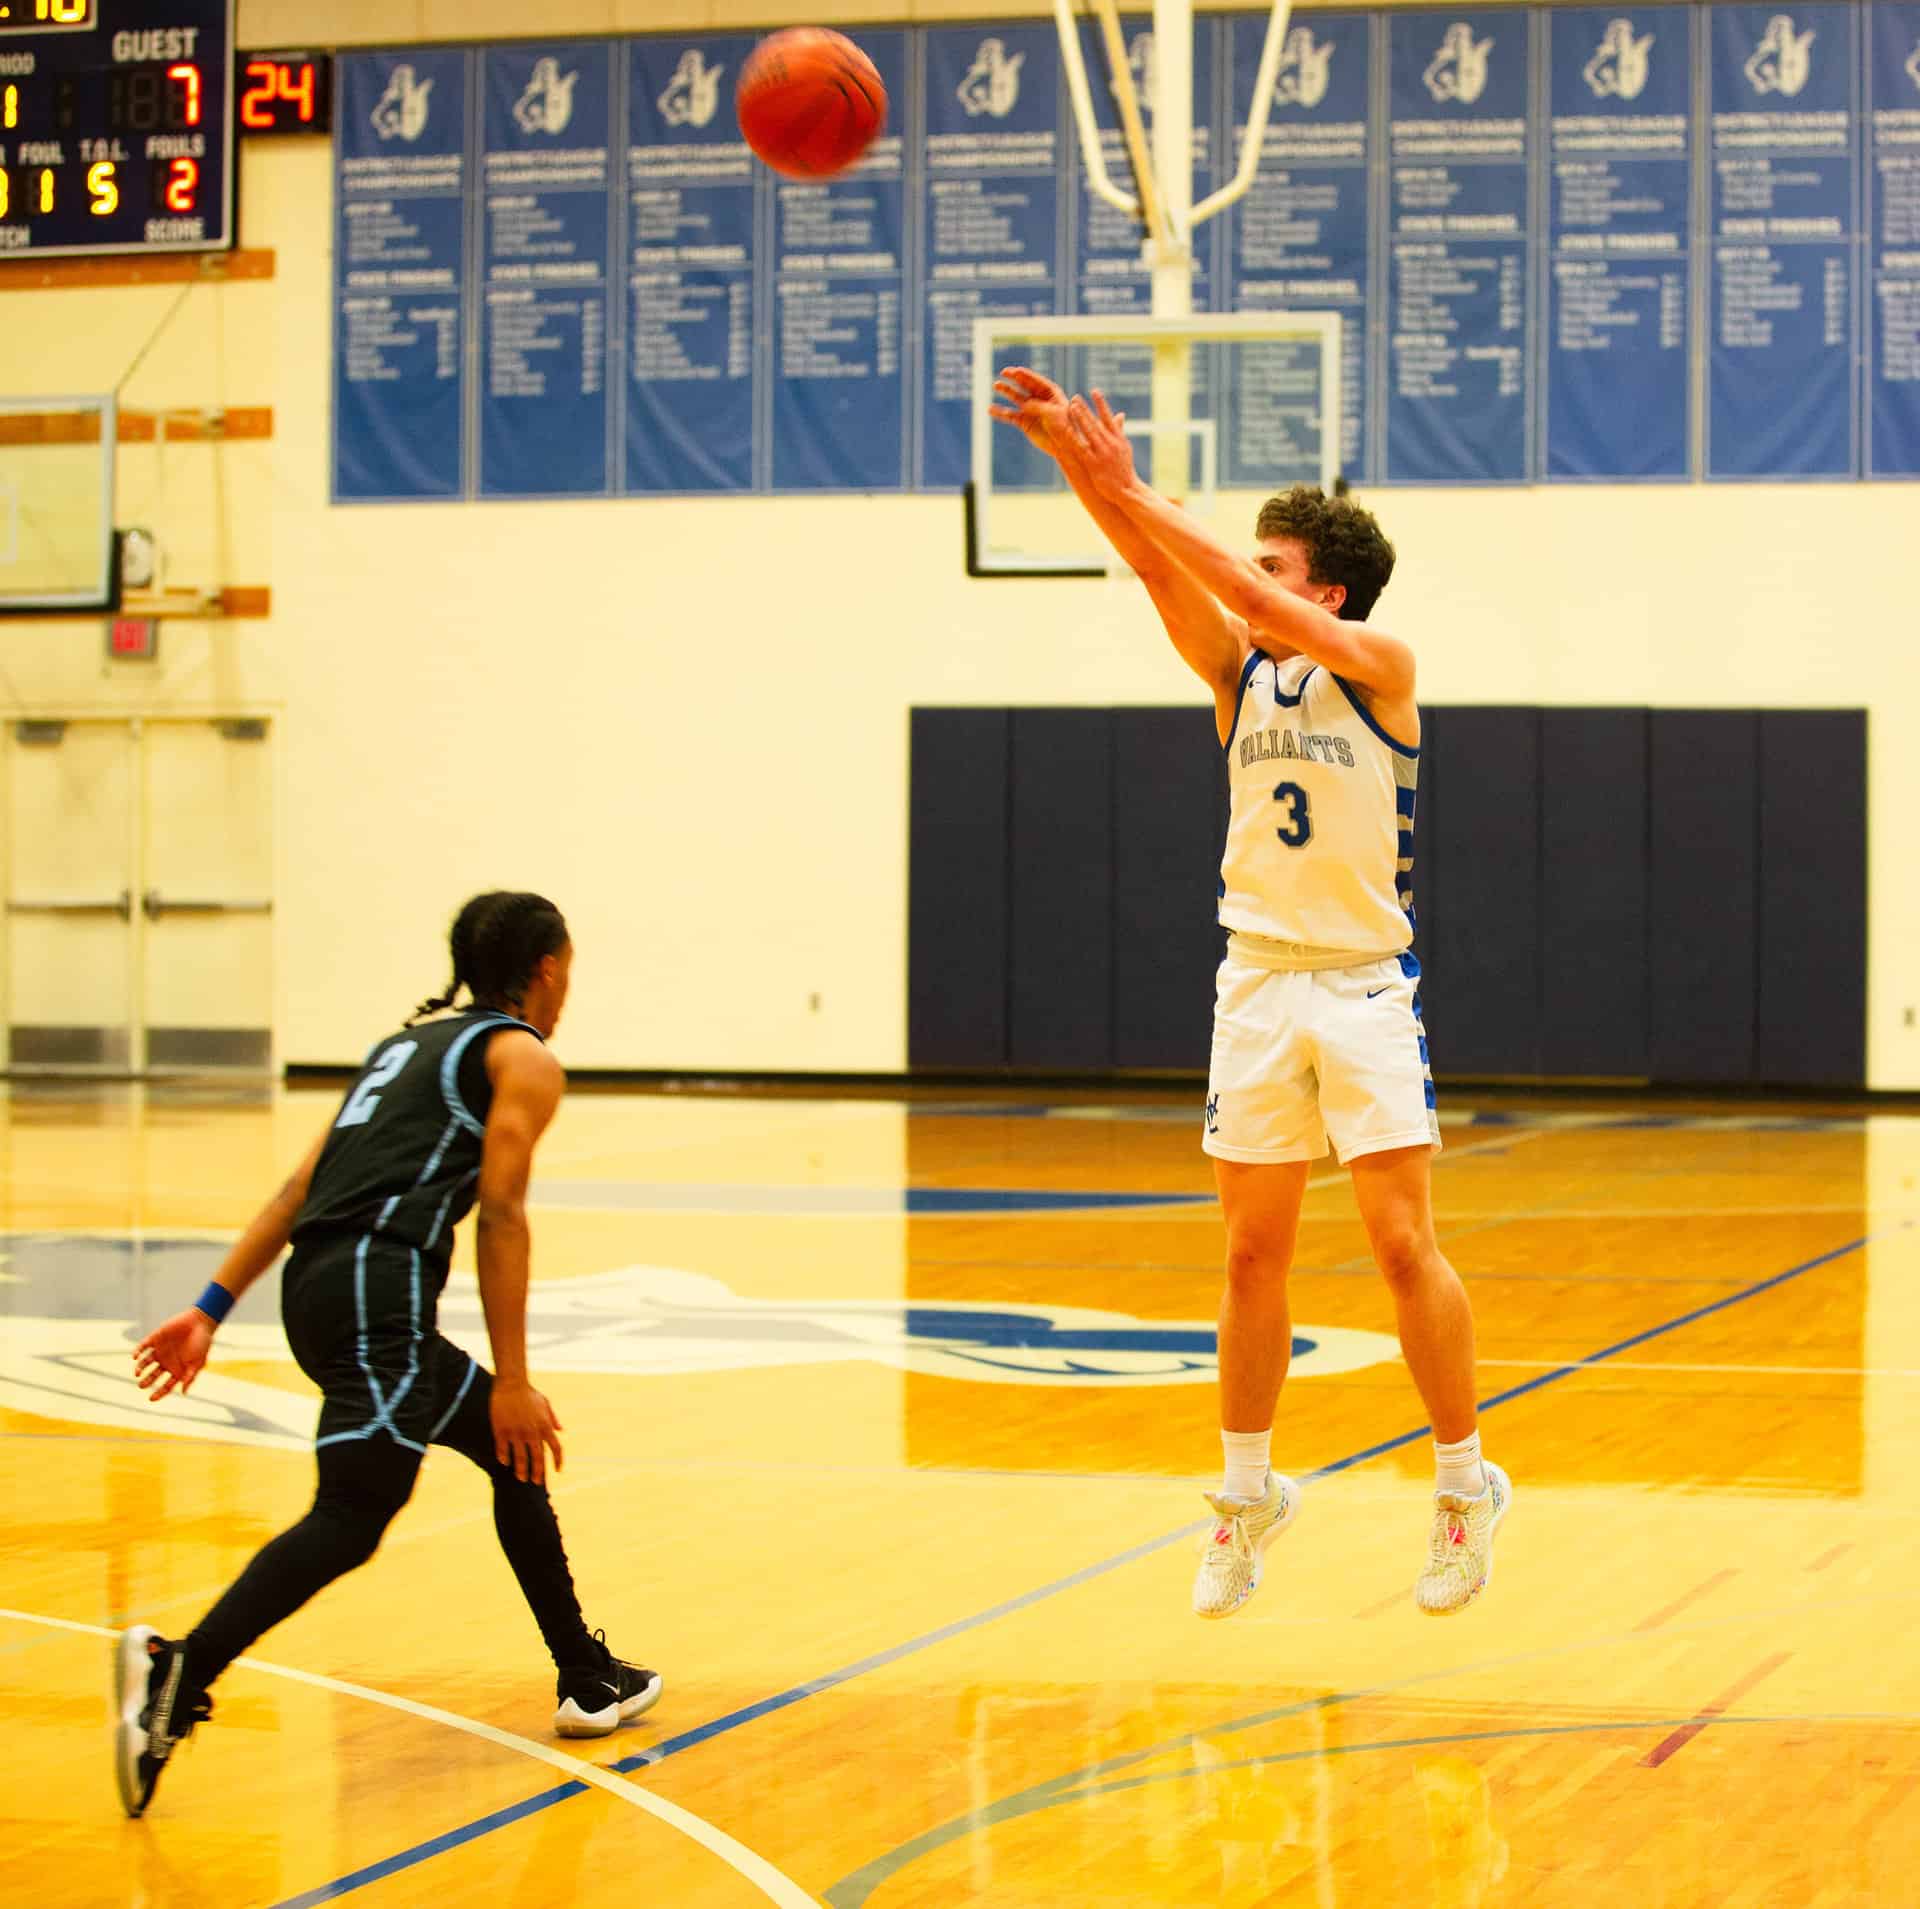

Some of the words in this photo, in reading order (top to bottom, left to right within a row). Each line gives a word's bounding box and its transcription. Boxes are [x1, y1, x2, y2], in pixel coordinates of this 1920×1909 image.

[112, 28, 199, 62] GUEST
[4, 84, 18, 129] 1
[166, 63, 201, 126] 7
[241, 61, 314, 128] 24
[18, 141, 65, 166] FOUL
[145, 134, 206, 160] FOULS
[40, 168, 55, 214] 1
[165, 156, 199, 212] 2
[1239, 729, 1355, 769] VALIANTS
[1273, 781, 1314, 849] 3
[335, 1039, 418, 1129] 2
